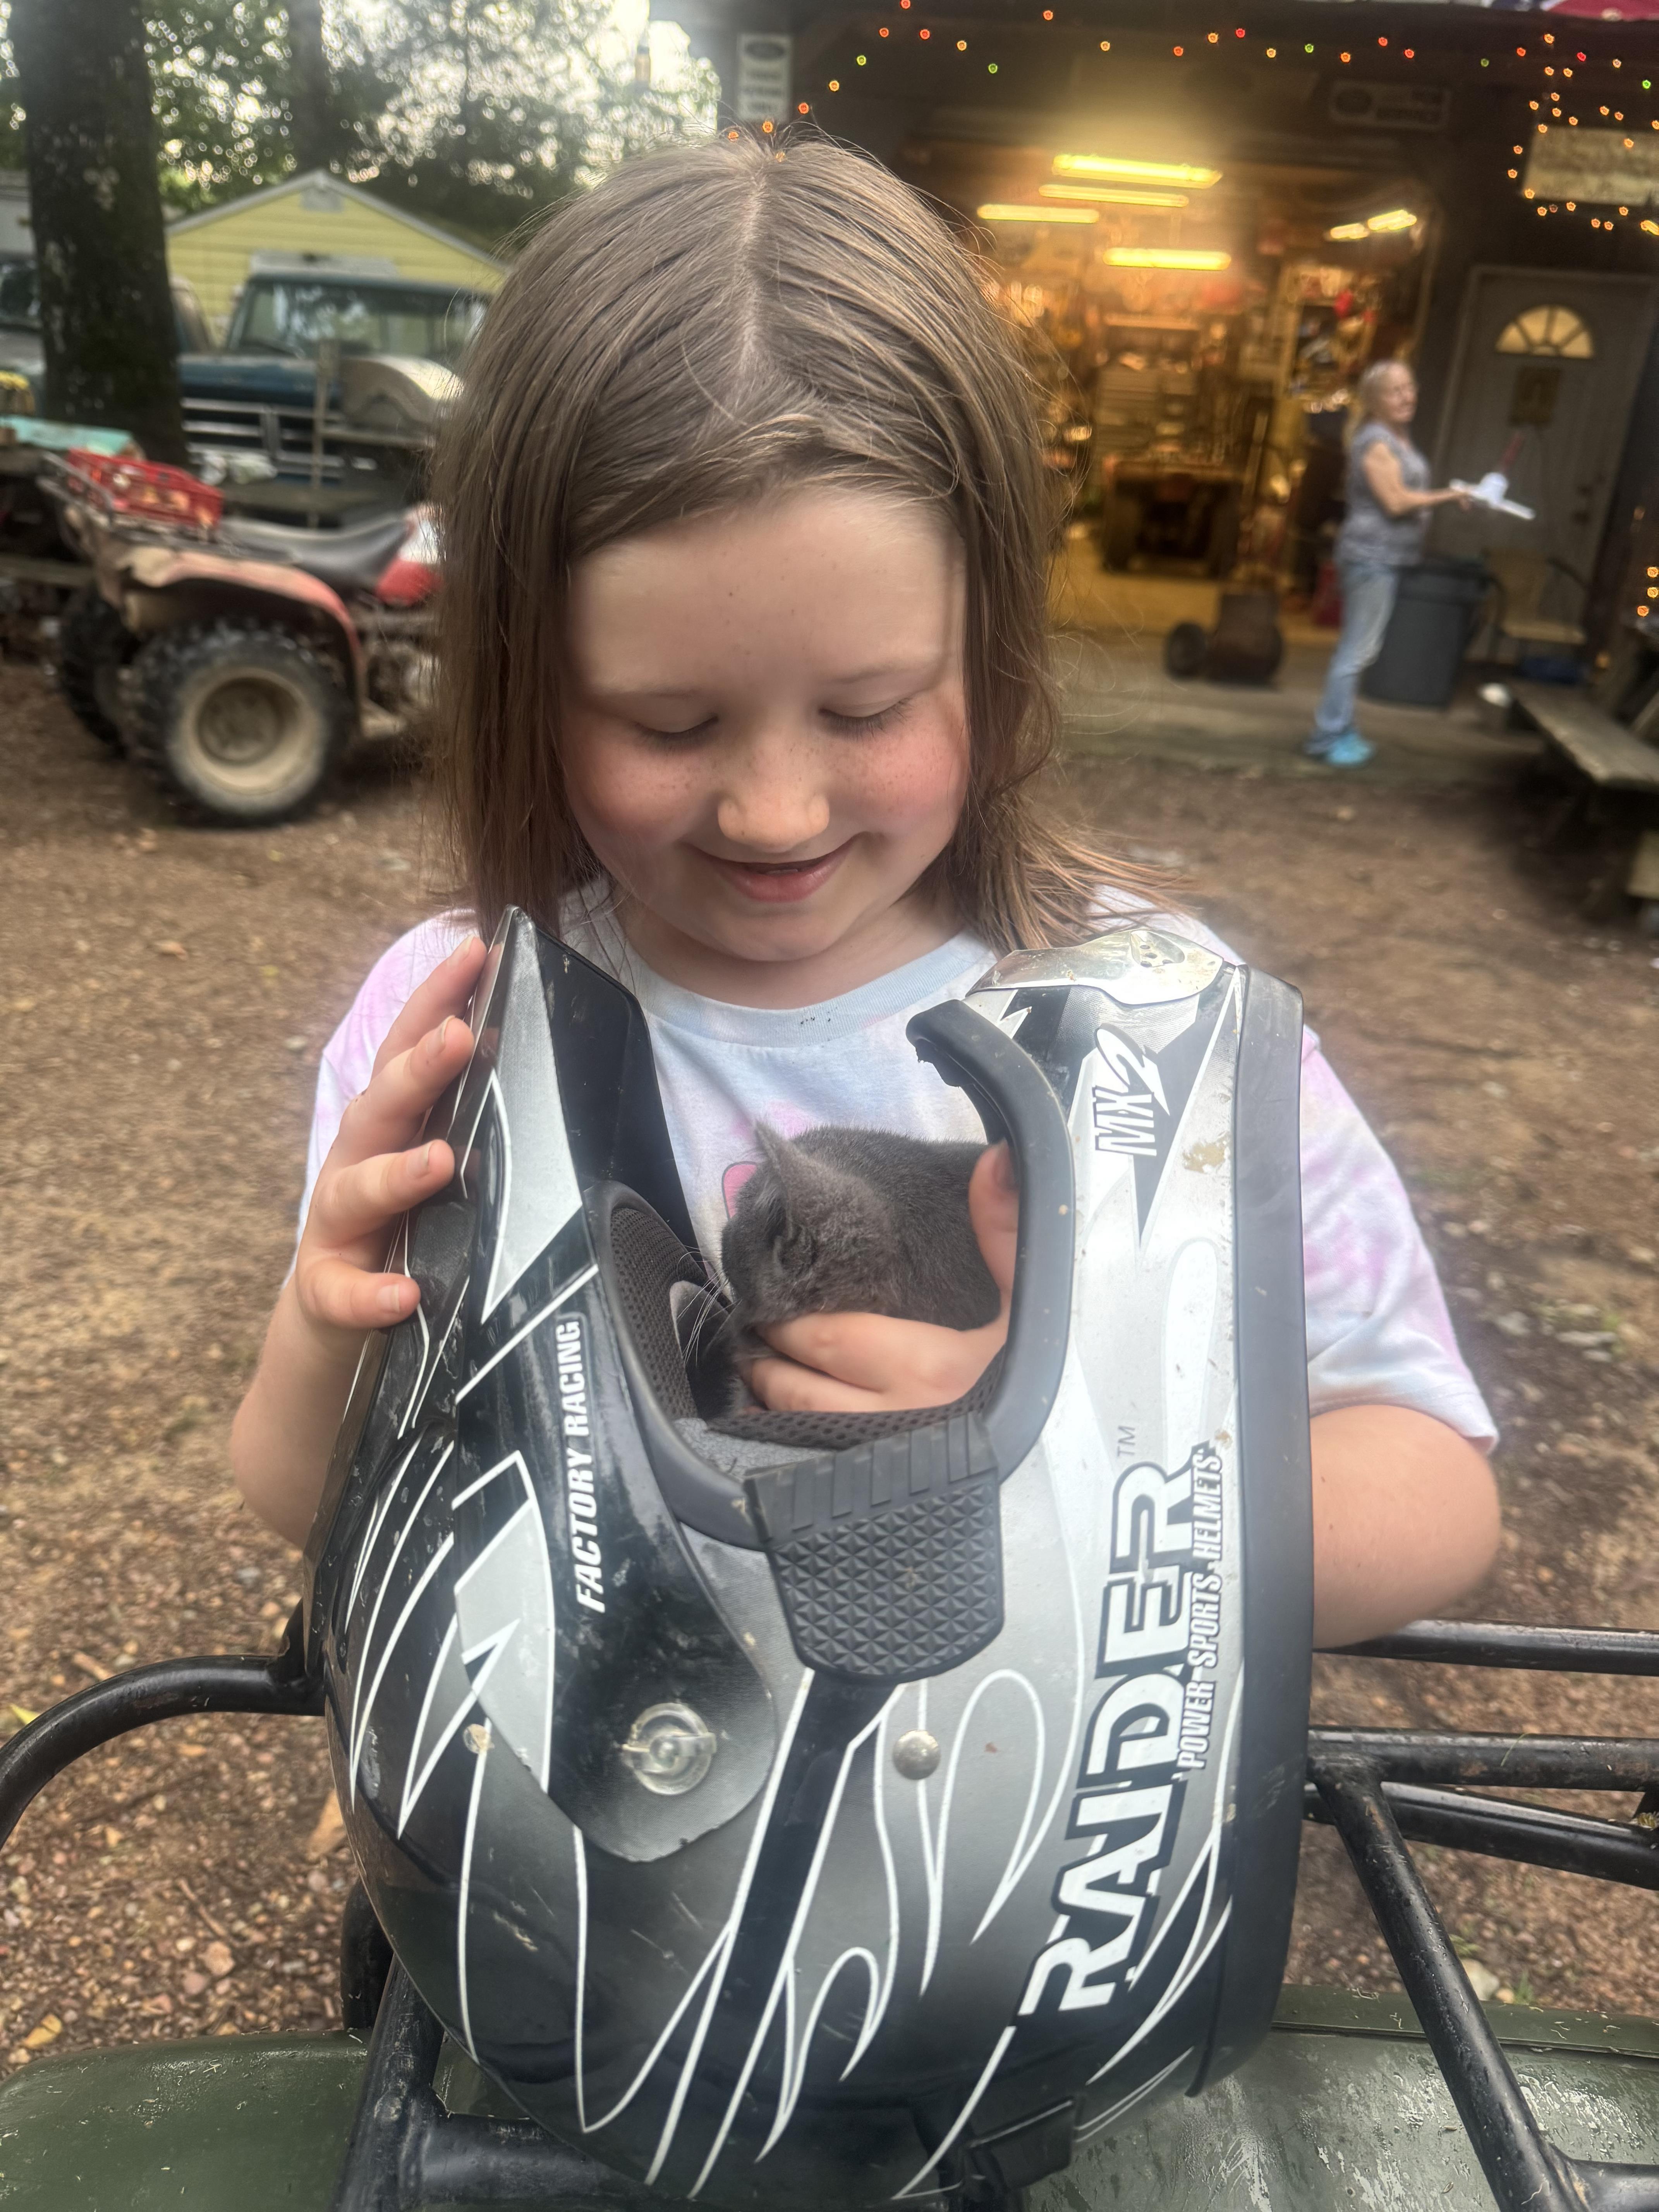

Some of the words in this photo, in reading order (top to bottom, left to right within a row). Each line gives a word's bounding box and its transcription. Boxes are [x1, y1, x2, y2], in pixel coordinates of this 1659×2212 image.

[1091, 1023, 1170, 1156] MX2
[556, 1320, 590, 1437] RACING
[567, 1447, 606, 1614] FACTORY
[1192, 1452, 1222, 1561] HELMETS
[1187, 1572, 1222, 1669] SPORTS
[1017, 1460, 1195, 2016] RAIDER
[1117, 1425, 1136, 1457] TM
[1178, 1679, 1214, 1770] POWER
